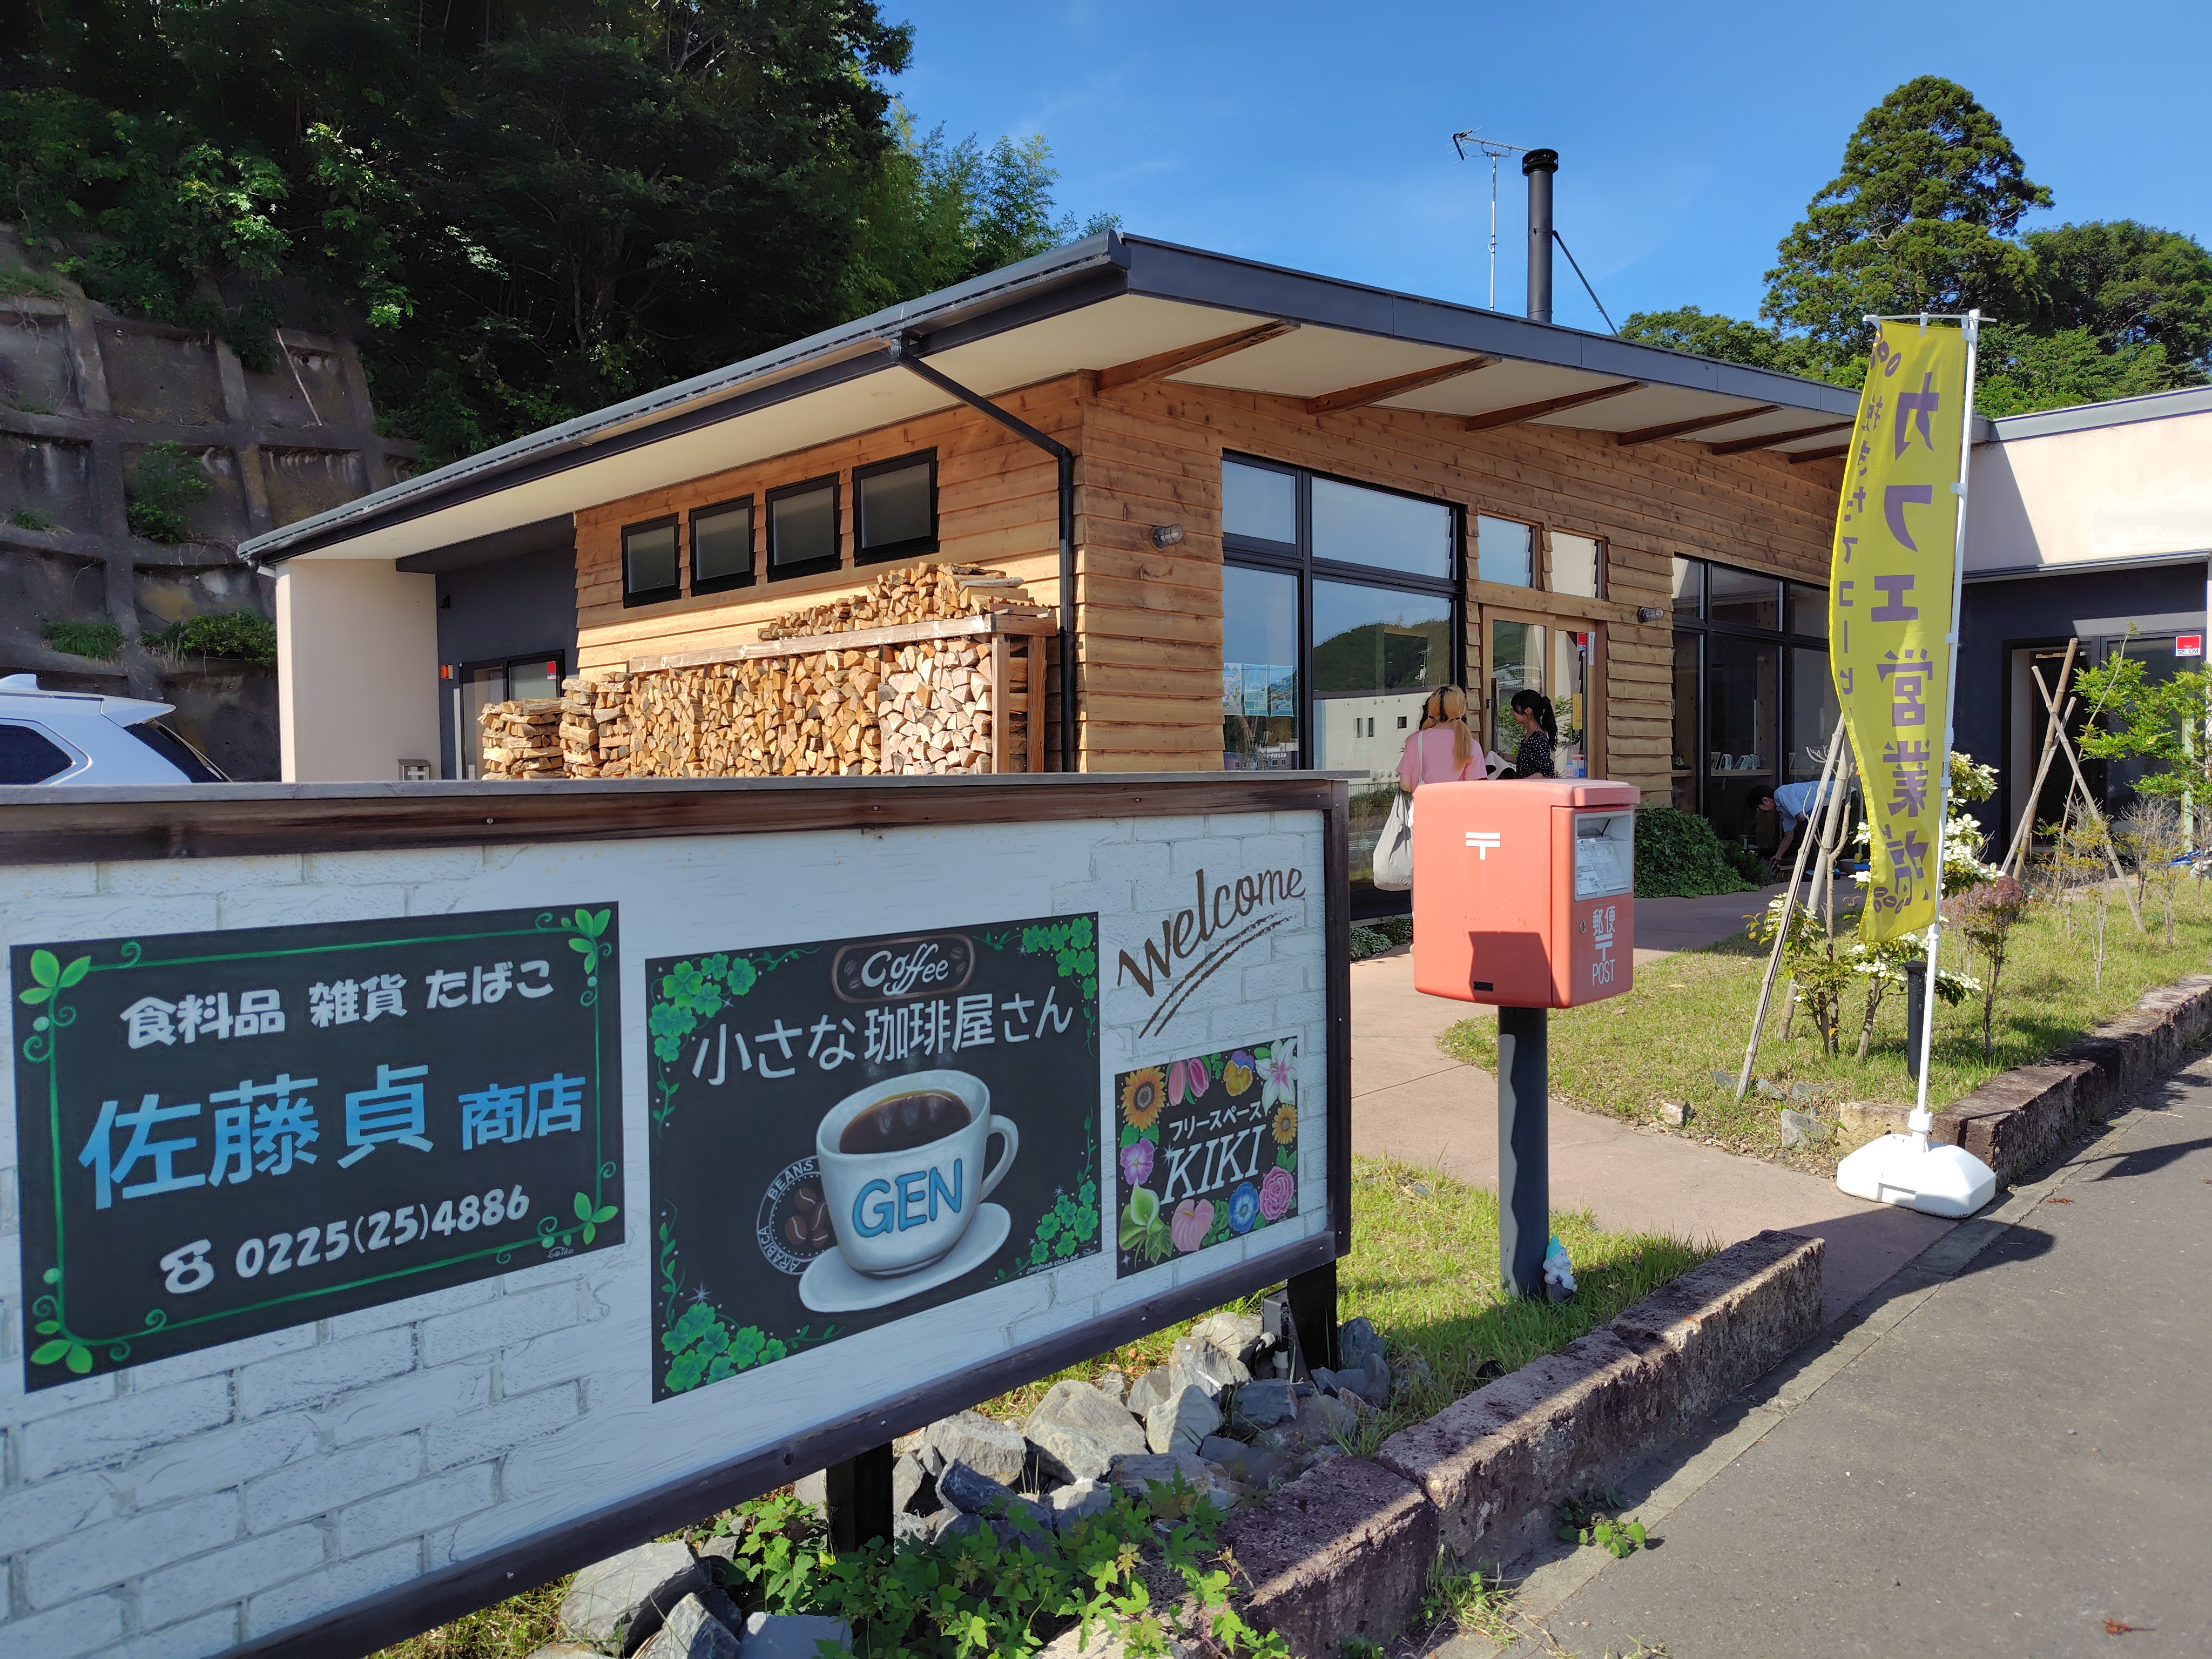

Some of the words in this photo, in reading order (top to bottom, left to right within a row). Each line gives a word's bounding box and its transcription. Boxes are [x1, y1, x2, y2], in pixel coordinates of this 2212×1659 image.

[1593, 906, 1615, 936] 郵便
[861, 943, 949, 996] Coffee
[1592, 959, 1615, 987] POST
[120, 988, 286, 1049] 食料品
[308, 974, 407, 1027] 雑貨
[426, 960, 554, 1010] たばこ
[692, 986, 1074, 1087] 小さな珈琲屋さん
[1169, 1101, 1262, 1142] フリースペース
[767, 1159, 814, 1201] BEANS
[1159, 1124, 1266, 1205] KIKI
[853, 1158, 963, 1238] GEN
[235, 1184, 530, 1279] 0225(25)4886
[758, 1225, 801, 1273] ARABICA
